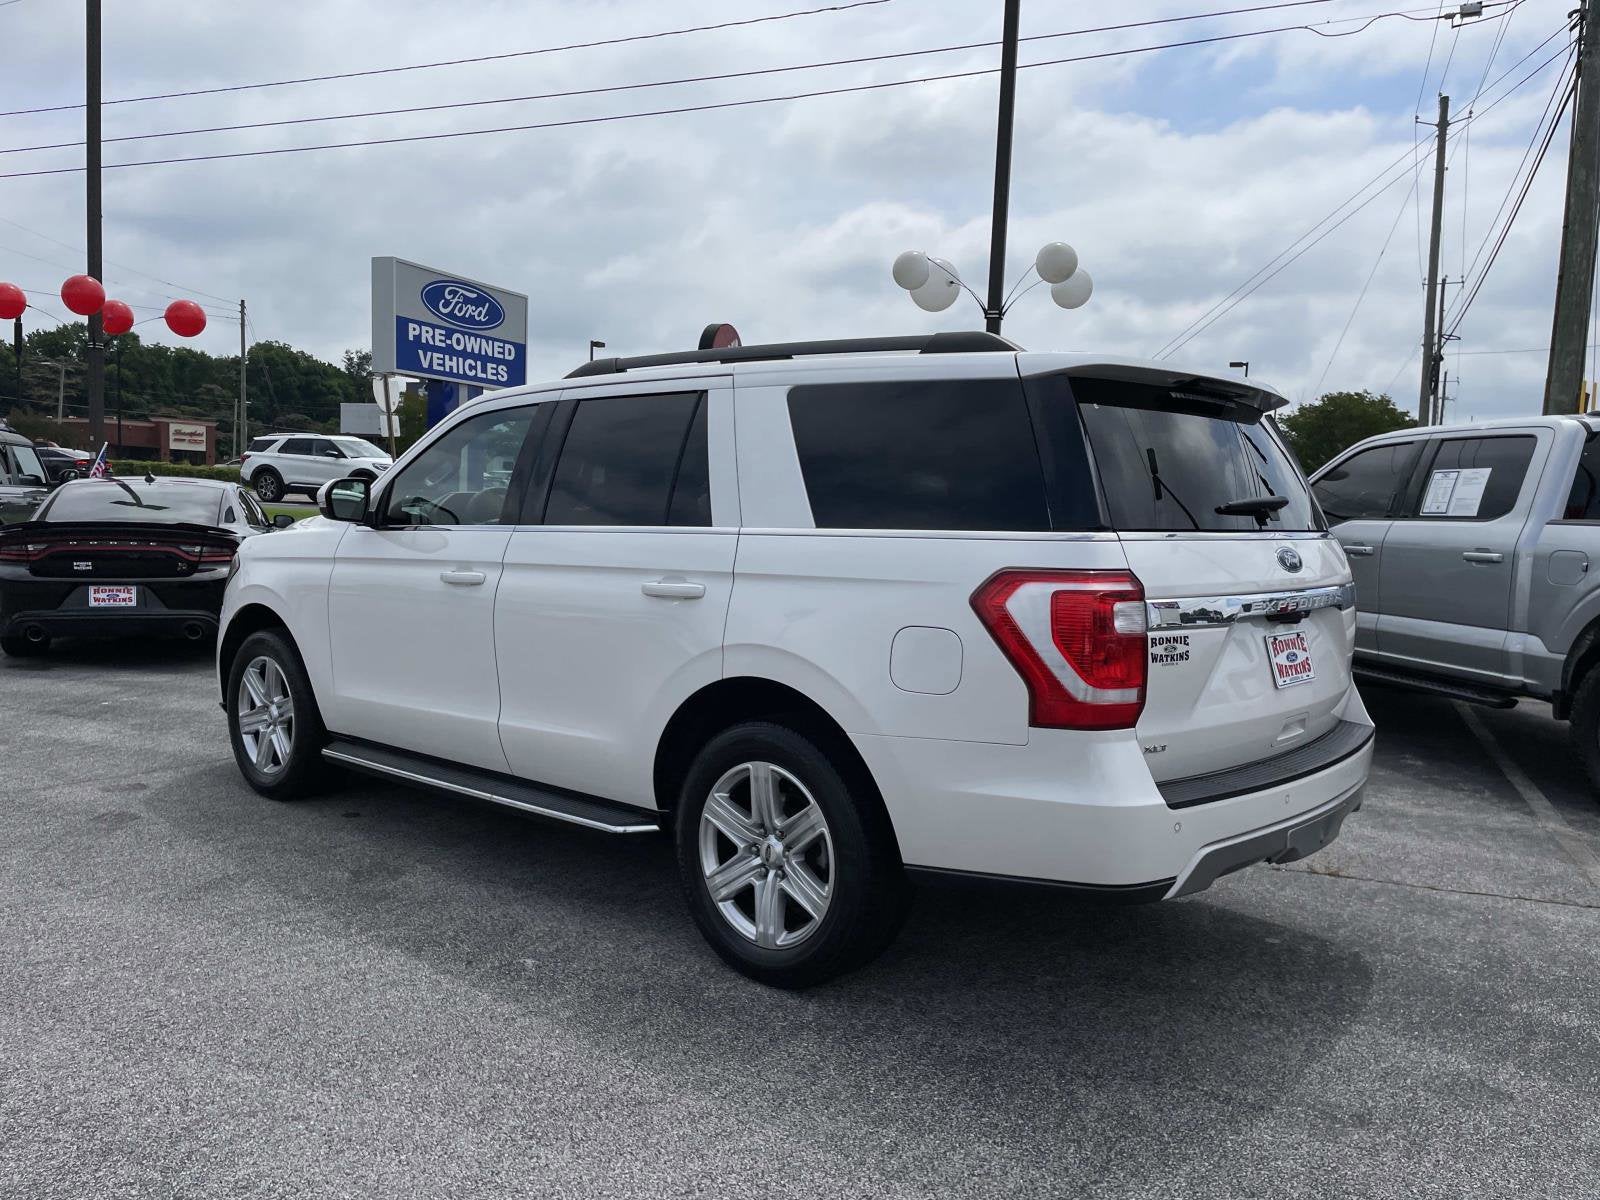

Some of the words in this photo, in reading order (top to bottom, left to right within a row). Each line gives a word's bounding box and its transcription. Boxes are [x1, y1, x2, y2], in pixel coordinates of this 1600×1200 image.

[438, 286, 489, 322] Ford
[407, 322, 516, 361] PRE-OWNED
[418, 349, 508, 382] VEHICLES
[1150, 636, 1190, 648] RONNIE
[1270, 637, 1307, 658] RONNIE
[1150, 650, 1190, 663] WATKINS
[1275, 656, 1312, 679] WATKINS
